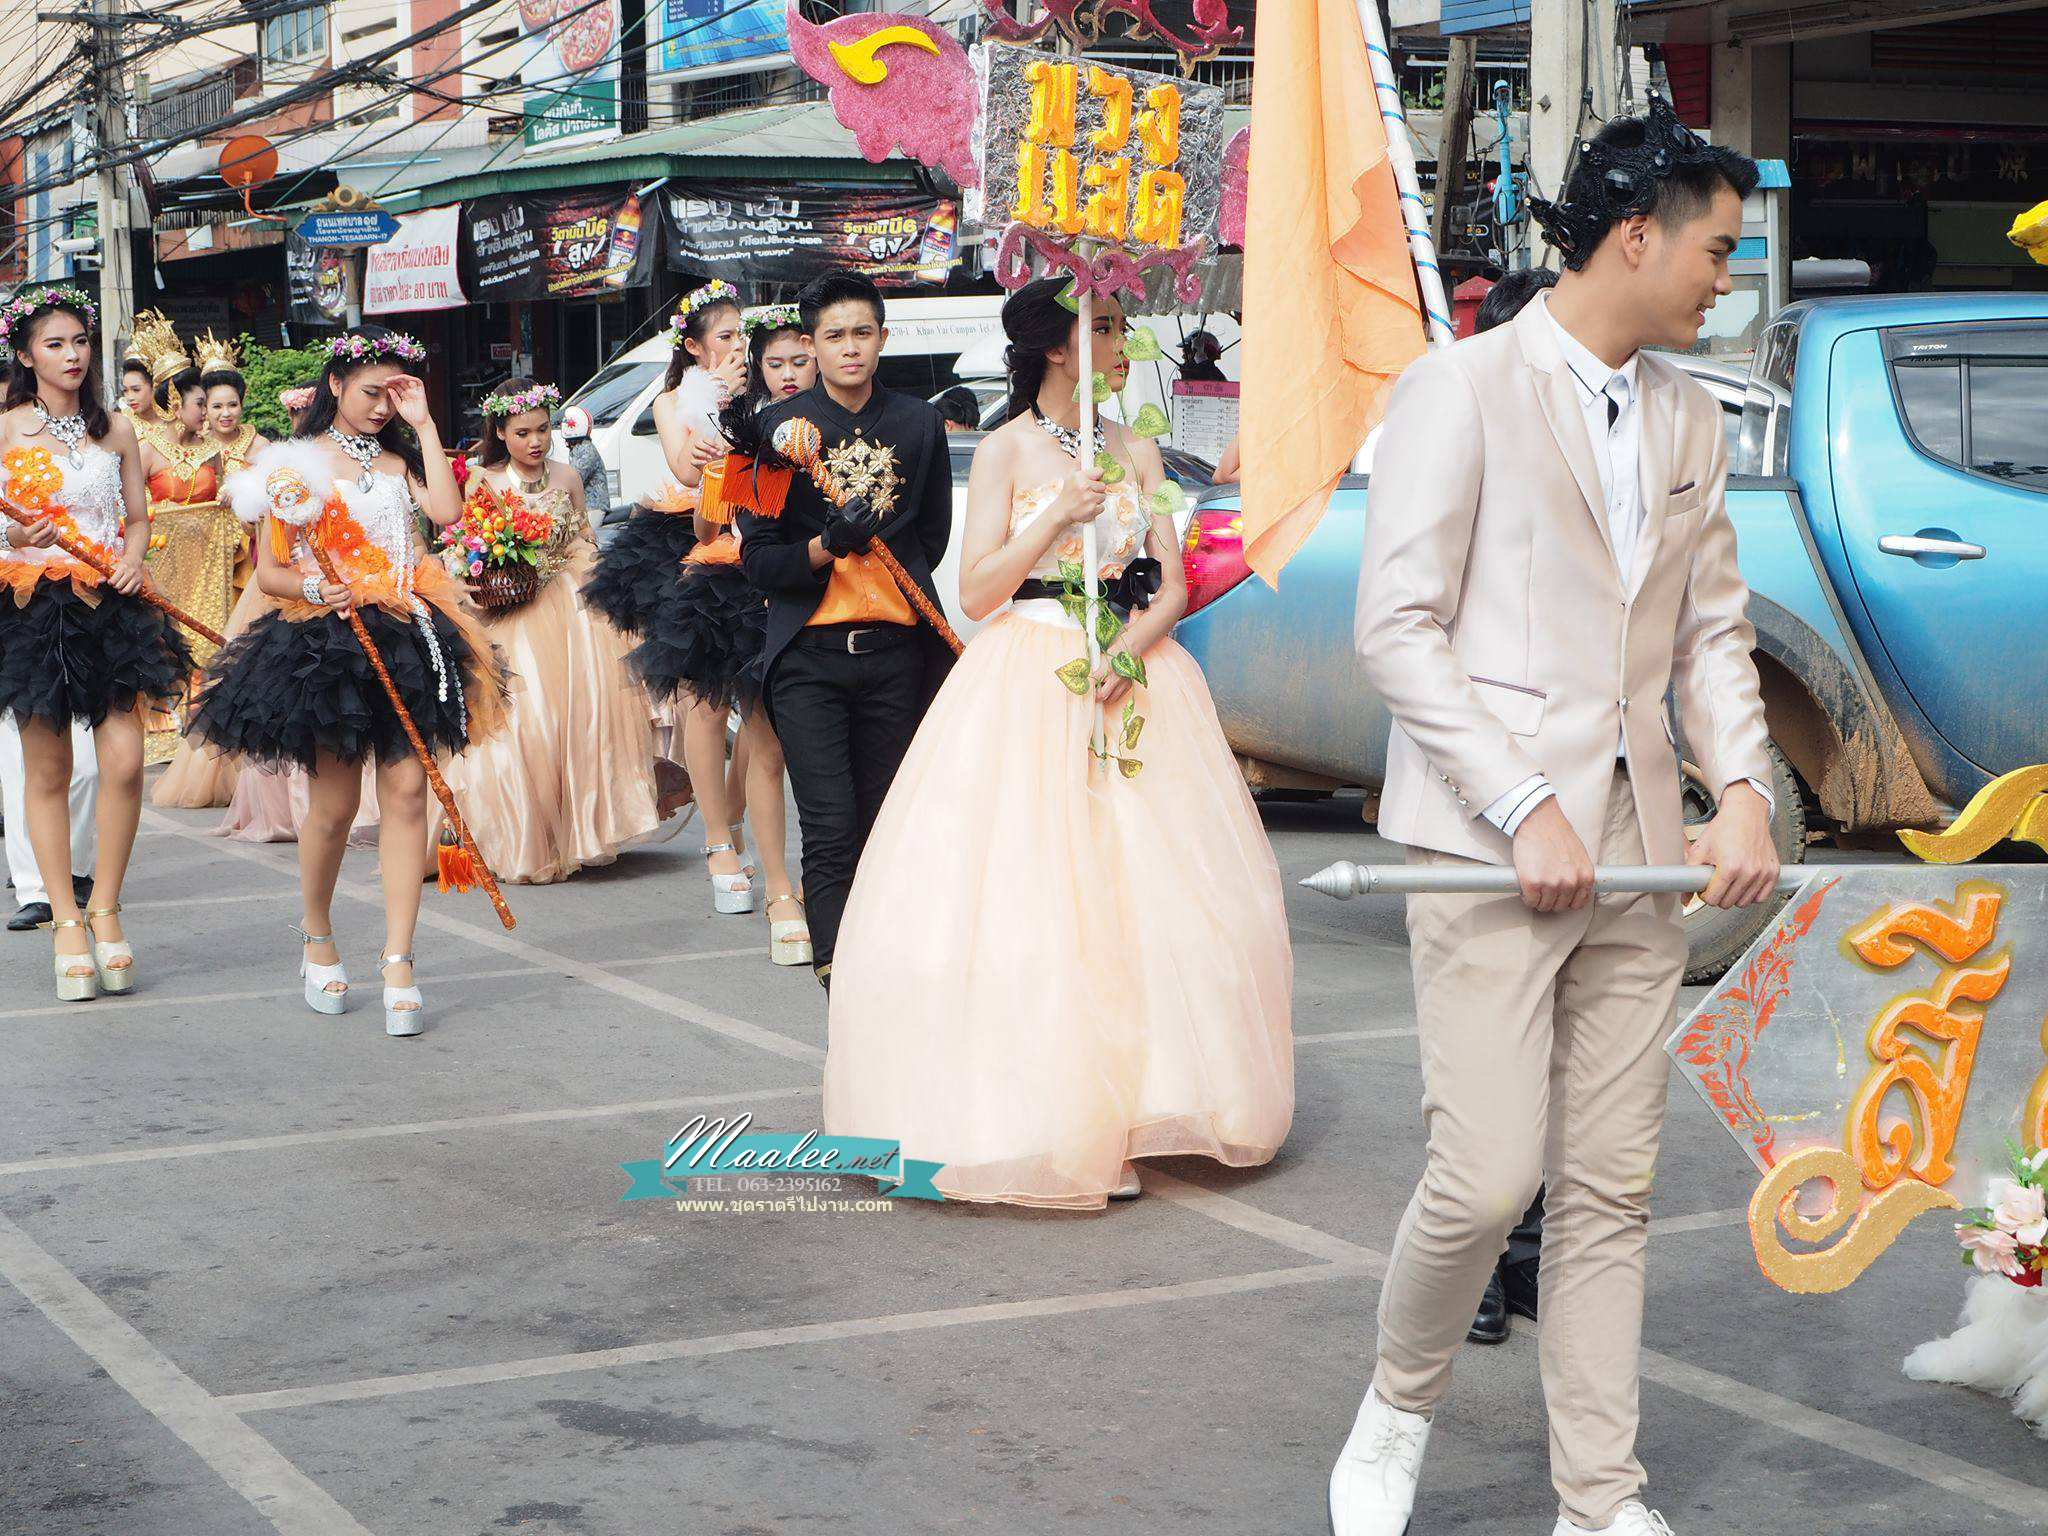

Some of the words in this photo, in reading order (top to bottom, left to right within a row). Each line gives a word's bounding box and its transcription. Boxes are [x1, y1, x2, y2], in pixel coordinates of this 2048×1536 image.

[1025, 61, 1182, 166] พวง
[670, 198, 732, 218] แรง
[1011, 142, 1186, 251] แสด
[473, 216, 500, 241] แรง
[567, 242, 595, 270] สูง
[869, 236, 903, 260] สูง
[1850, 893, 2048, 1191] สี
